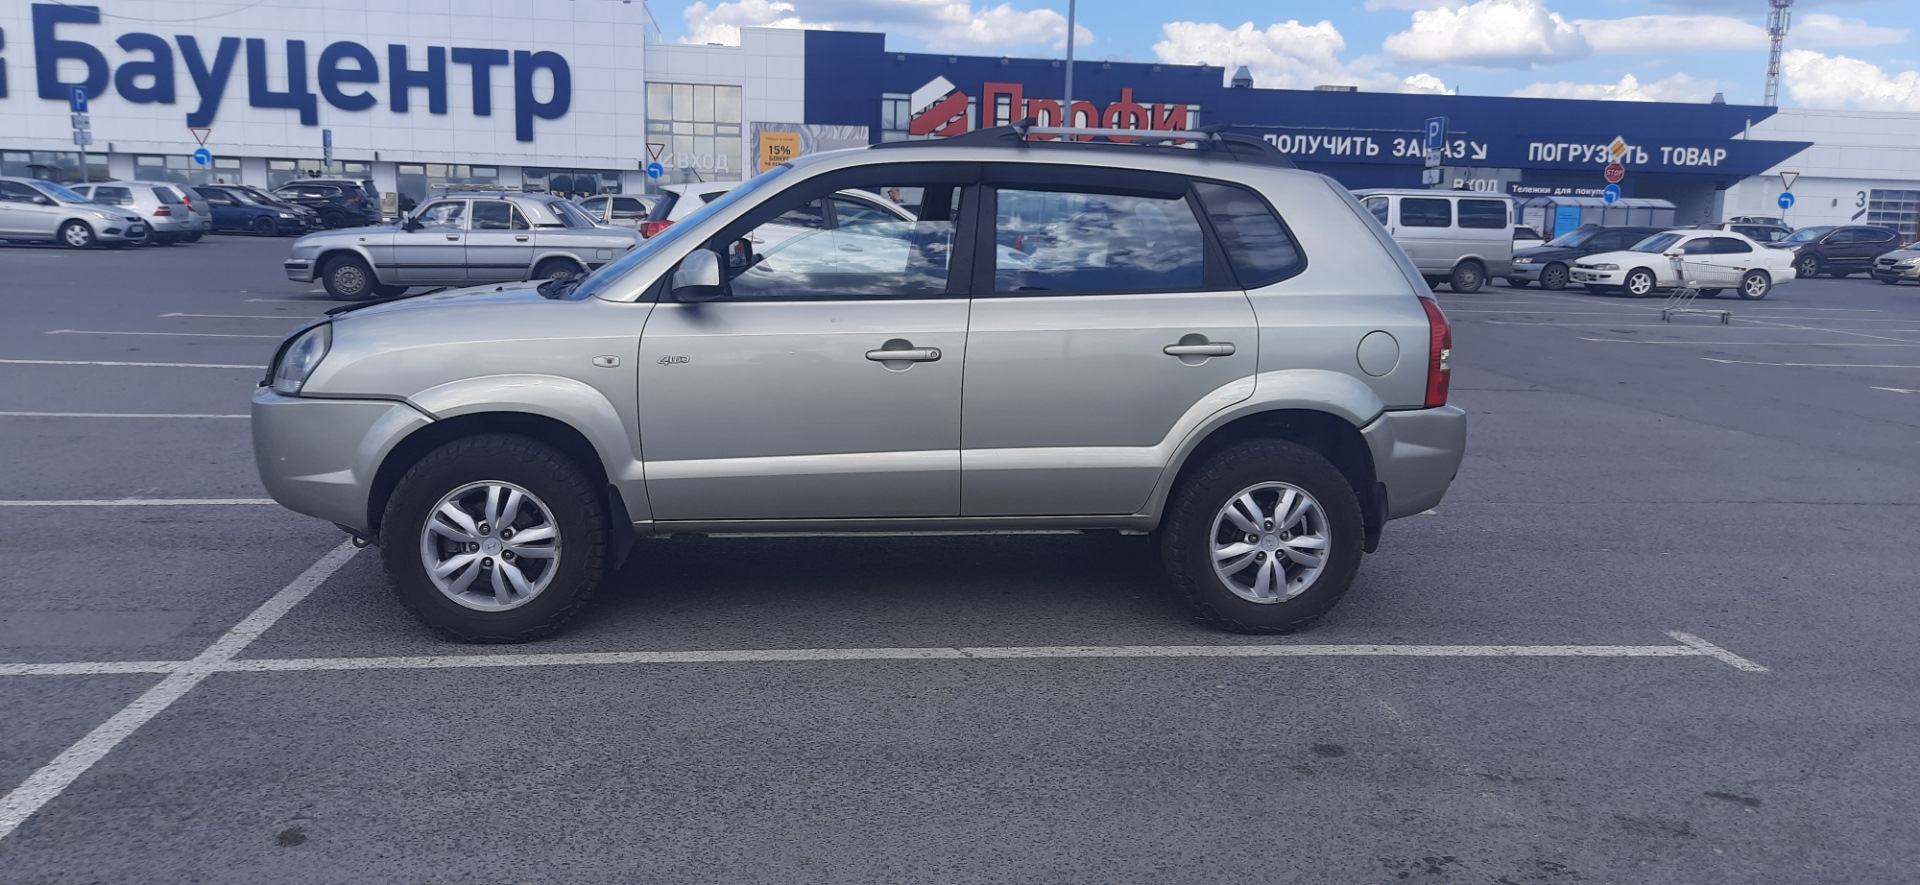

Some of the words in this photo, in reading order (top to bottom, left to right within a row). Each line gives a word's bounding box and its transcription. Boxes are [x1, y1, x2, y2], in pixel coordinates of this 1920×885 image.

[31, 3, 572, 142] Бауцентр
[982, 82, 1188, 145] Профи
[1428, 121, 1439, 145] P
[769, 145, 791, 155] 15%
[1392, 138, 1466, 159] ЗААЗ
[1660, 147, 1726, 166] ТОВАР
[677, 153, 728, 173] ВХОД
[1512, 185, 1550, 193] Тележки
[1855, 191, 1866, 208] 3
